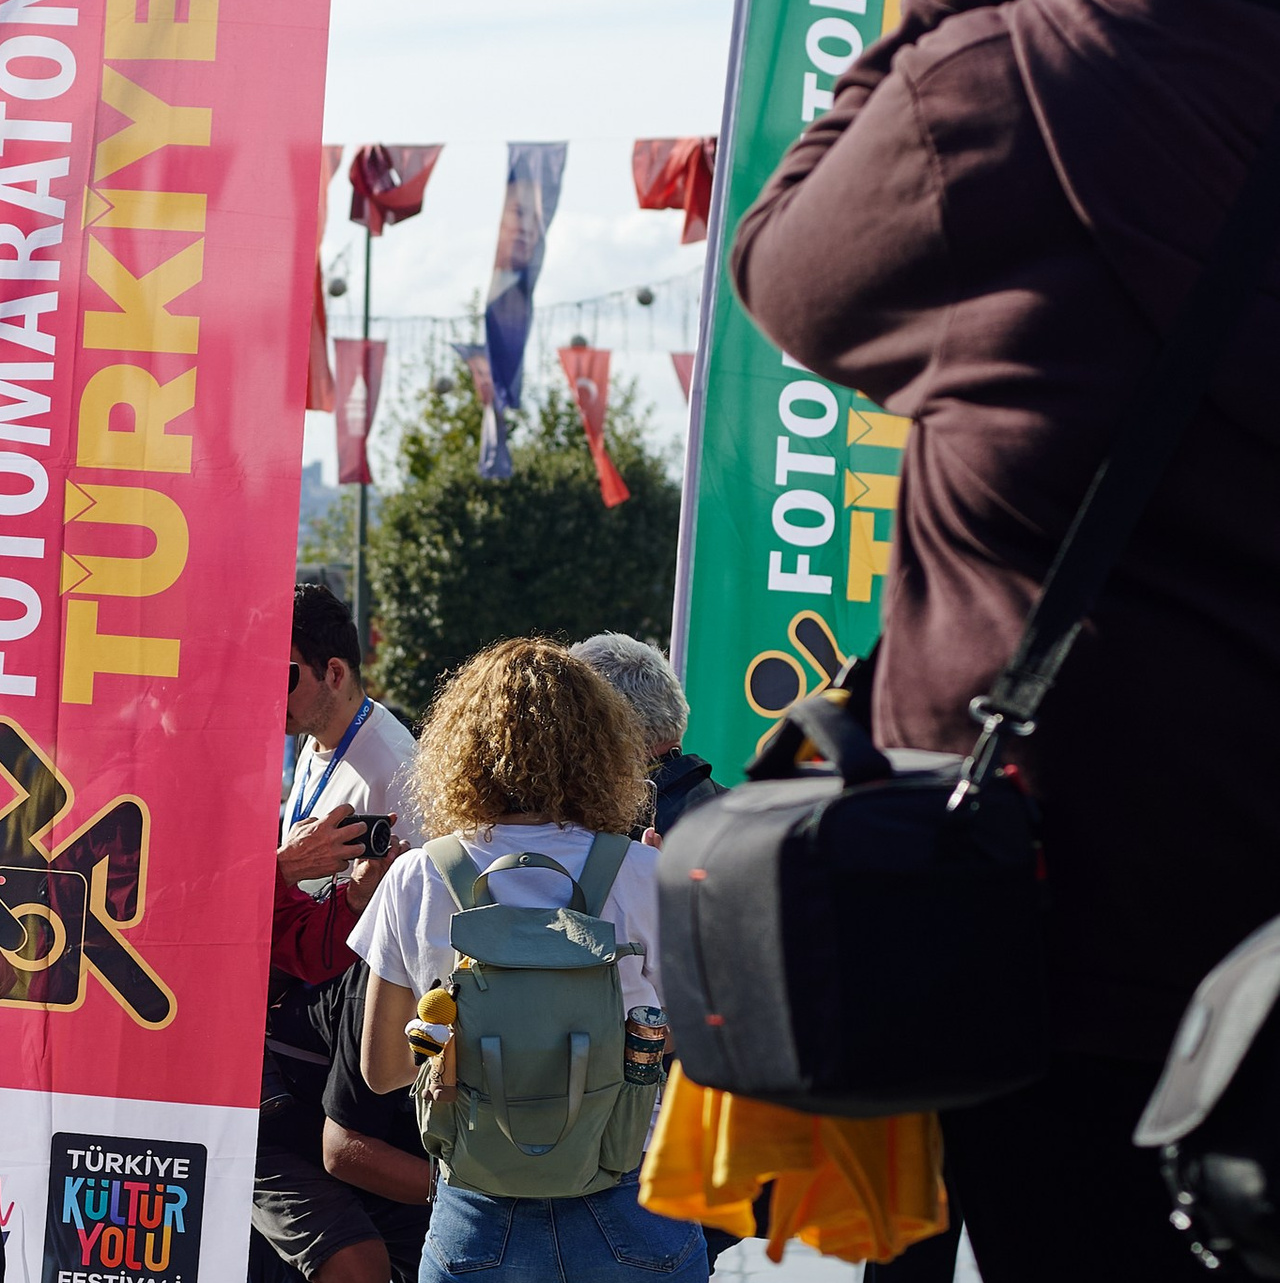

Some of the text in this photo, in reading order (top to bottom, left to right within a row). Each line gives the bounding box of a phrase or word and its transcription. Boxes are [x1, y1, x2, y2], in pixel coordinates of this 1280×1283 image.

[354, 704, 371, 726] vivo
[66, 1145, 190, 1179] TÜRKİYE
[62, 1176, 188, 1233] KÜLTÜR
[76, 1223, 172, 1272] YOLU
